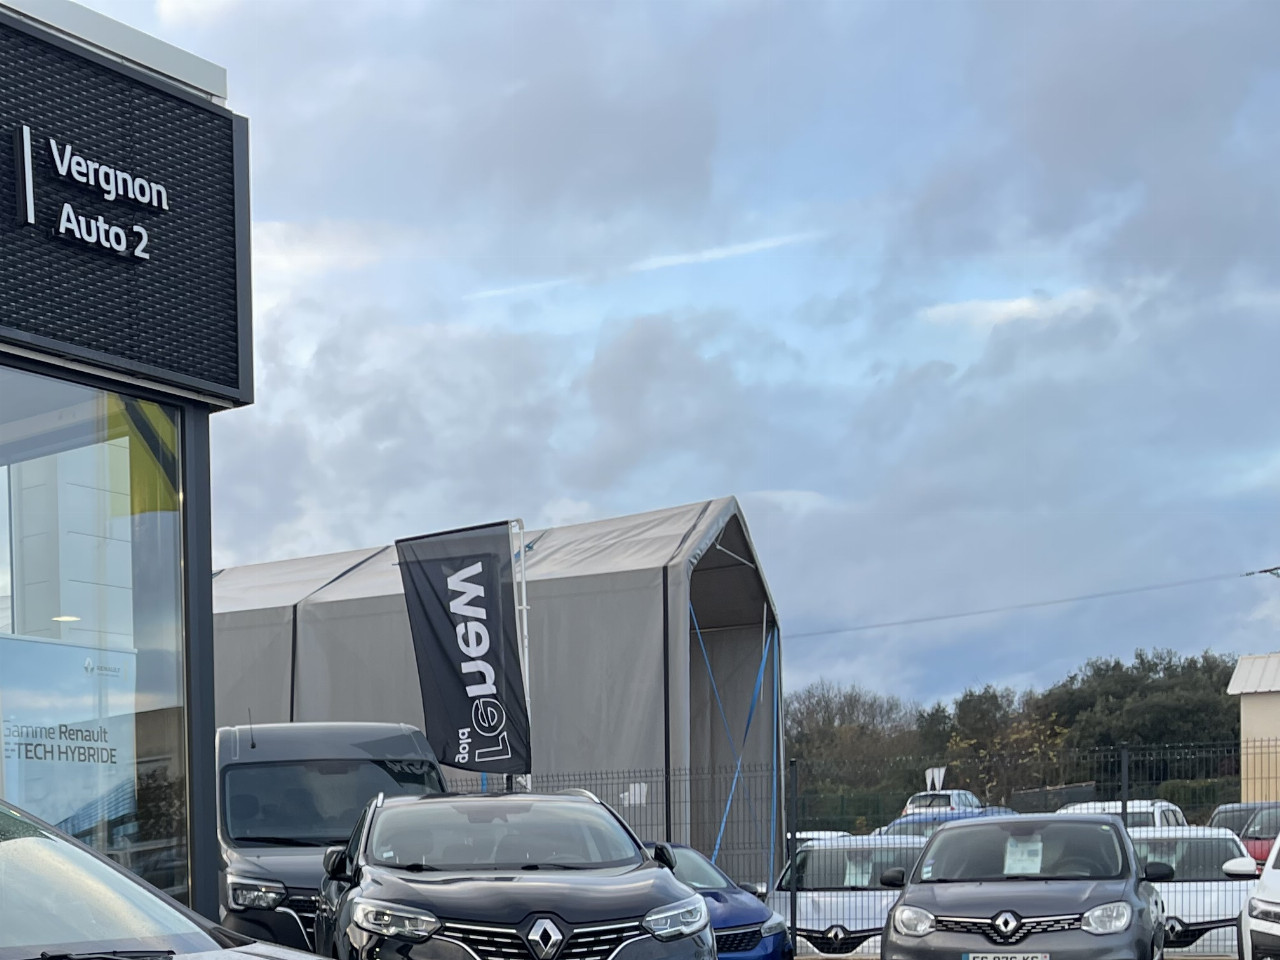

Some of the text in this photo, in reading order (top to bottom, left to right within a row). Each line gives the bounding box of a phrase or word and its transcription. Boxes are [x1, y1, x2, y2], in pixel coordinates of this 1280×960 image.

[49, 138, 169, 210] Vergnon
[59, 203, 150, 259] Auto 2
[58, 724, 109, 743] Renault
[57, 744, 118, 764] HYBRIDE
